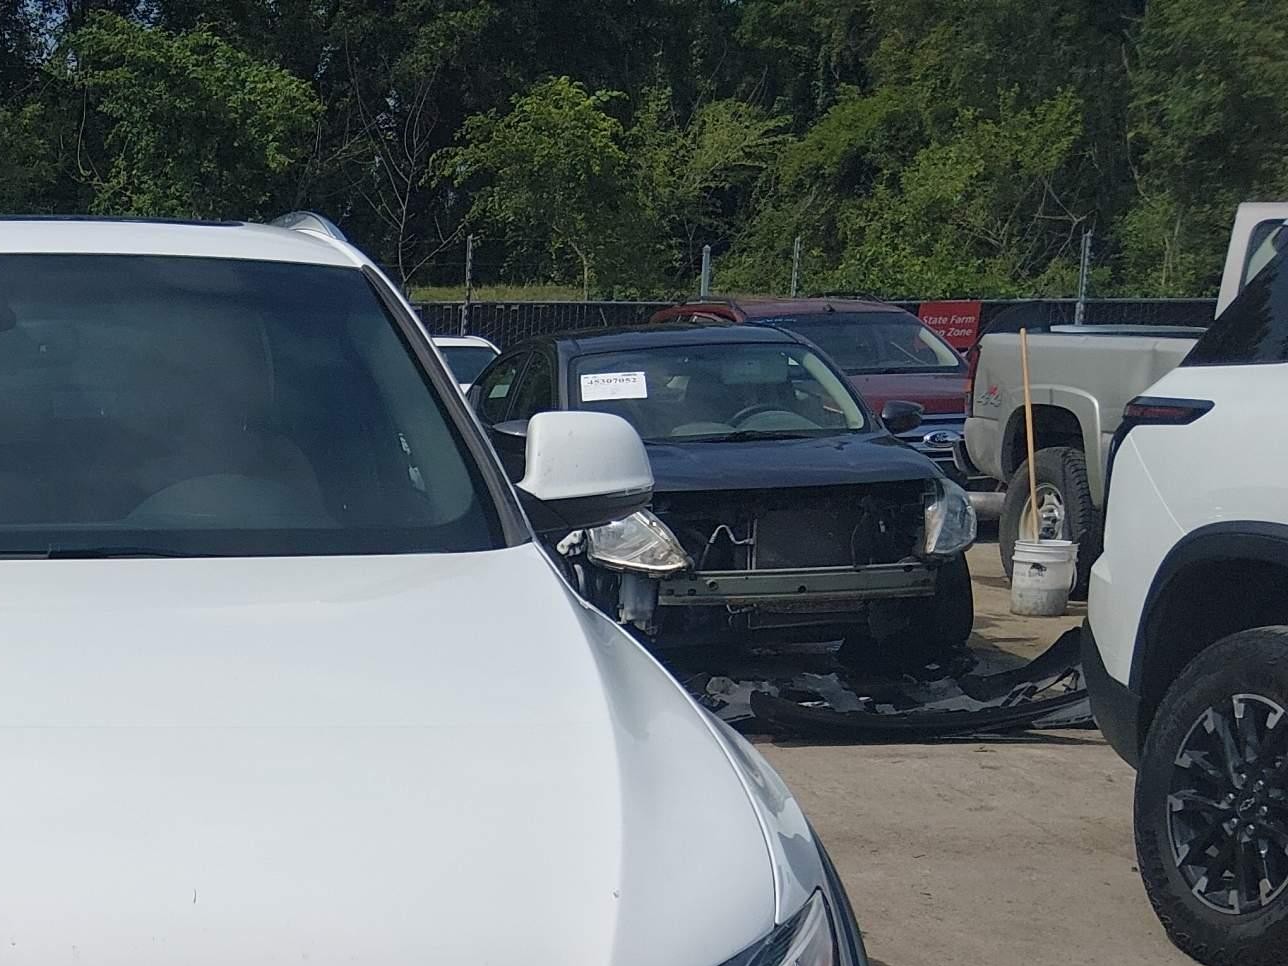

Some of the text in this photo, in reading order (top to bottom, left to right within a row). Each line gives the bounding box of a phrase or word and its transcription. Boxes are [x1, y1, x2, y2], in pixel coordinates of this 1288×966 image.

[923, 314, 976, 325] State Farm
[946, 327, 973, 337] Zone
